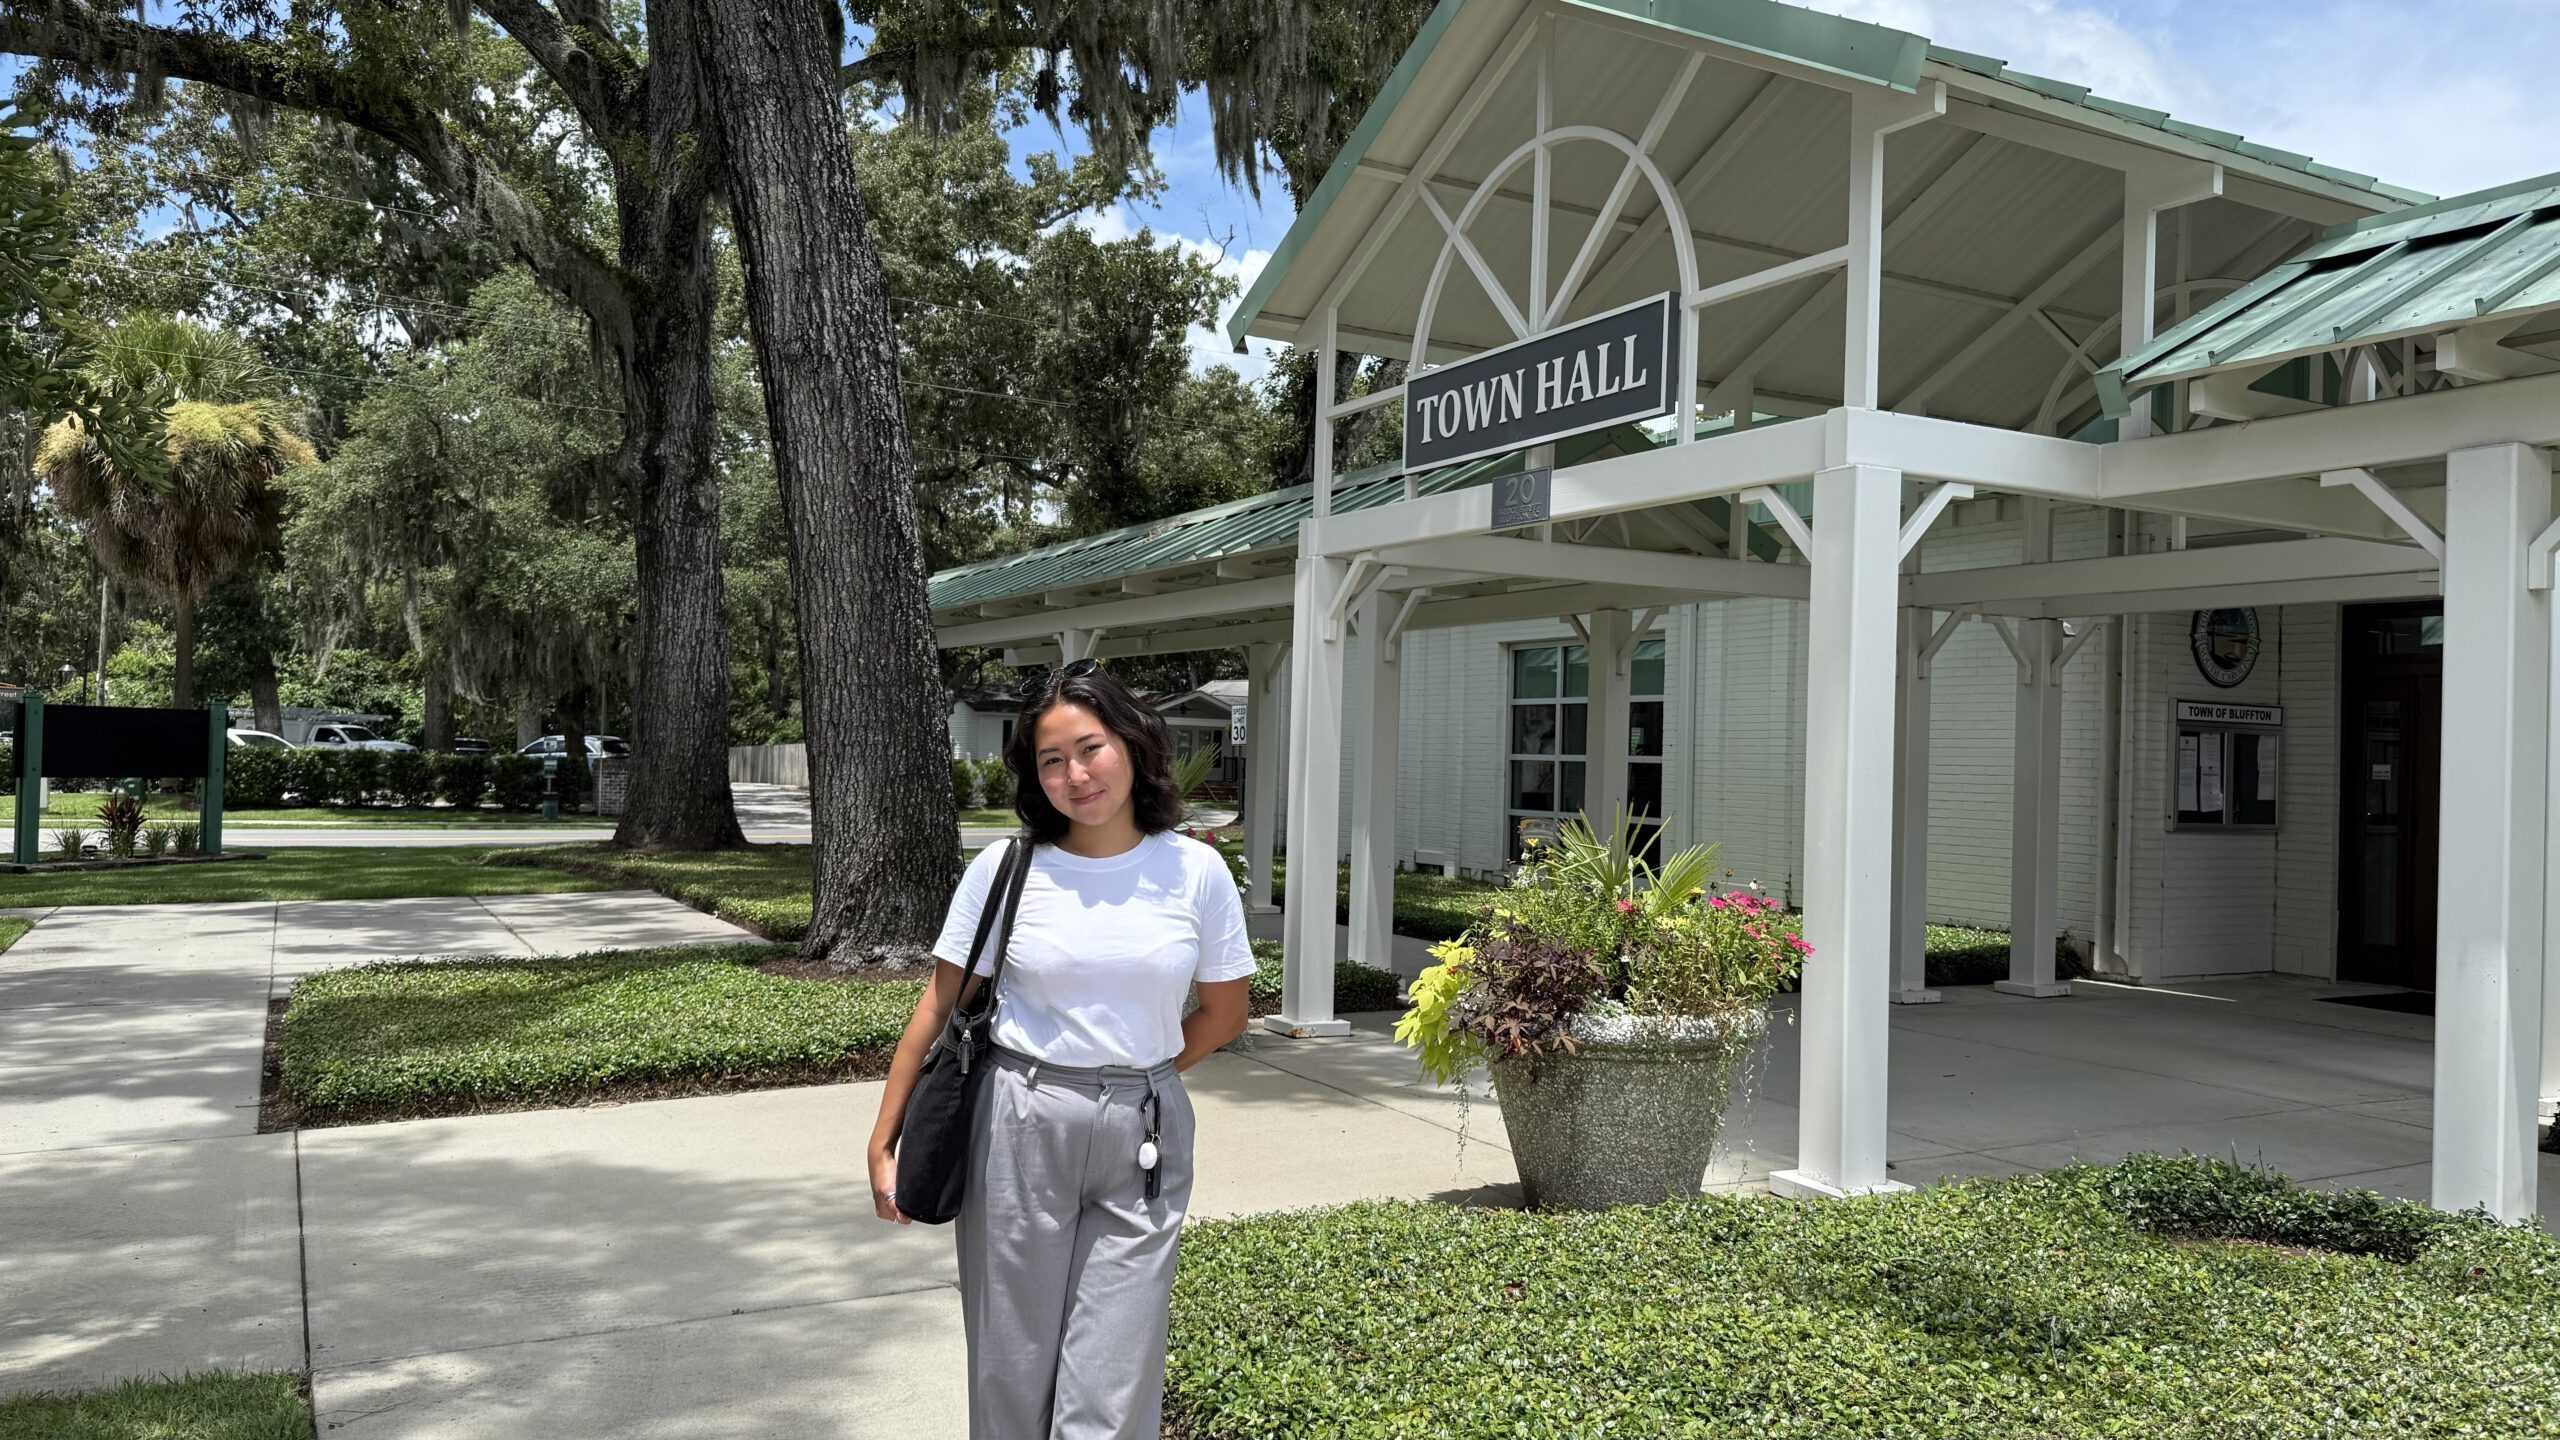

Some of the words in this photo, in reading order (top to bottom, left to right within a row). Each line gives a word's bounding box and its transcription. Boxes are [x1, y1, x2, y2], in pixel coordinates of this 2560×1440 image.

[1416, 368, 1525, 444] TOWN
[1535, 334, 1647, 414] HALL
[1505, 474, 1535, 507] 20
[2188, 706, 2213, 718] TOWN
[2216, 708, 2227, 719] OF
[2229, 708, 2271, 721] BLUFFTON
[1233, 726, 1246, 741] 30
